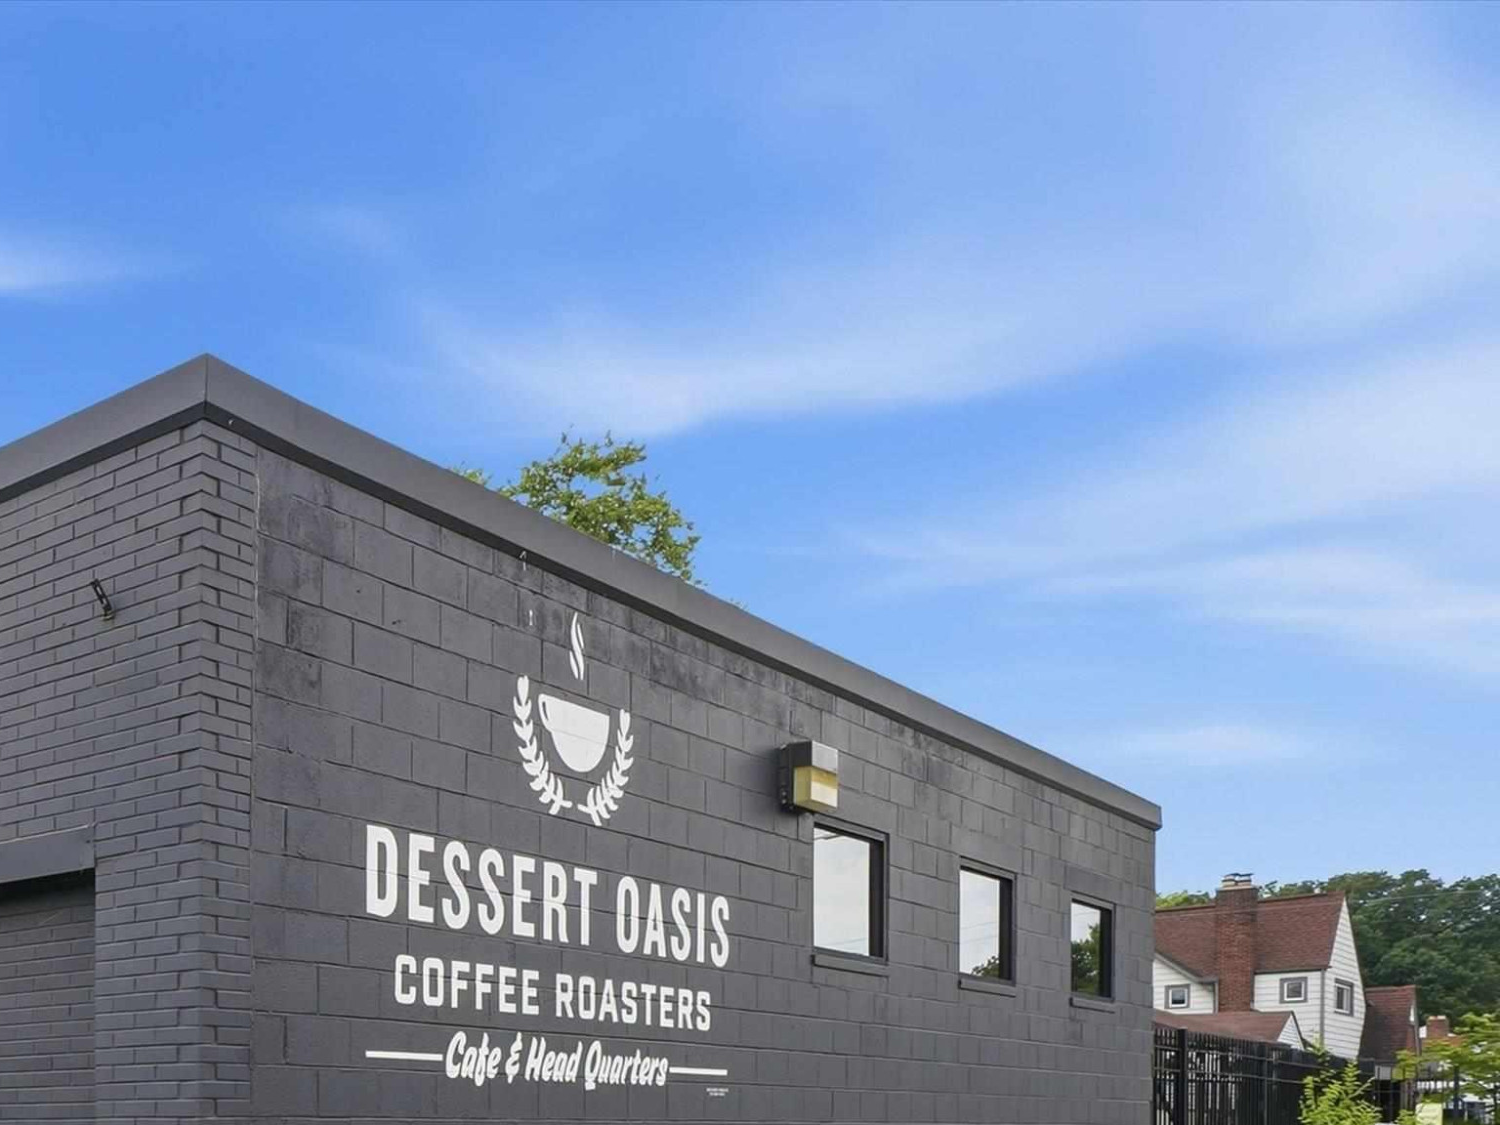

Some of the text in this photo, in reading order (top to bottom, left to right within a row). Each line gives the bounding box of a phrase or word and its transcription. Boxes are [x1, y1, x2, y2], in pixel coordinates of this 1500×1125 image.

[366, 824, 730, 968] DESSERT OASIS
[394, 954, 711, 1031] COFFEE ROASTERS
[445, 1030, 668, 1091] Cafe & Head Quarters
